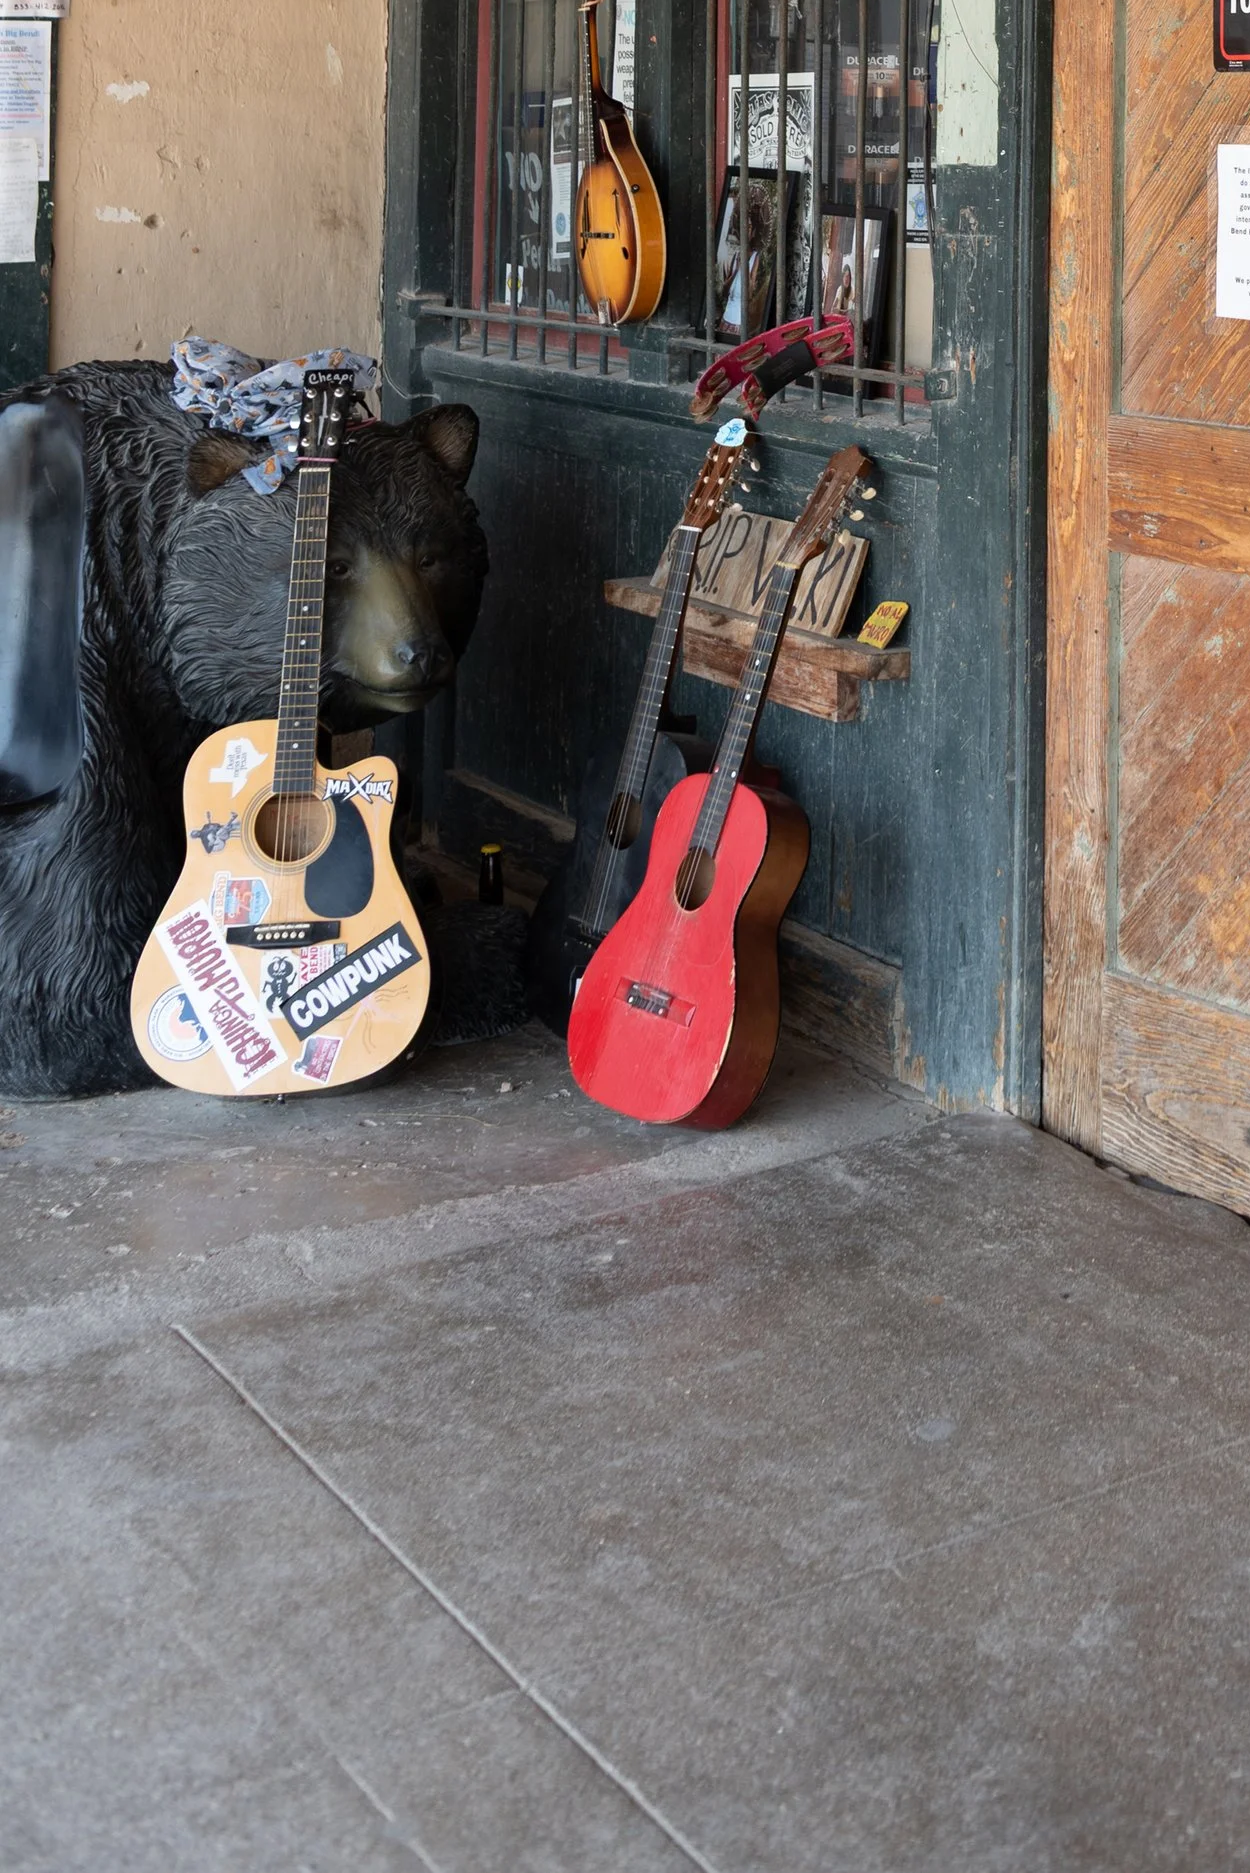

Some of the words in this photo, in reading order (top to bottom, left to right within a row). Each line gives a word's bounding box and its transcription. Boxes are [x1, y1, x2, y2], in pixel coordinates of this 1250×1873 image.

[750, 121, 774, 144] SOLD
[1234, 167, 1246, 175] The
[1230, 227, 1247, 235] Bend
[309, 946, 319, 974] BEND
[290, 933, 412, 1028] COWPUNK
